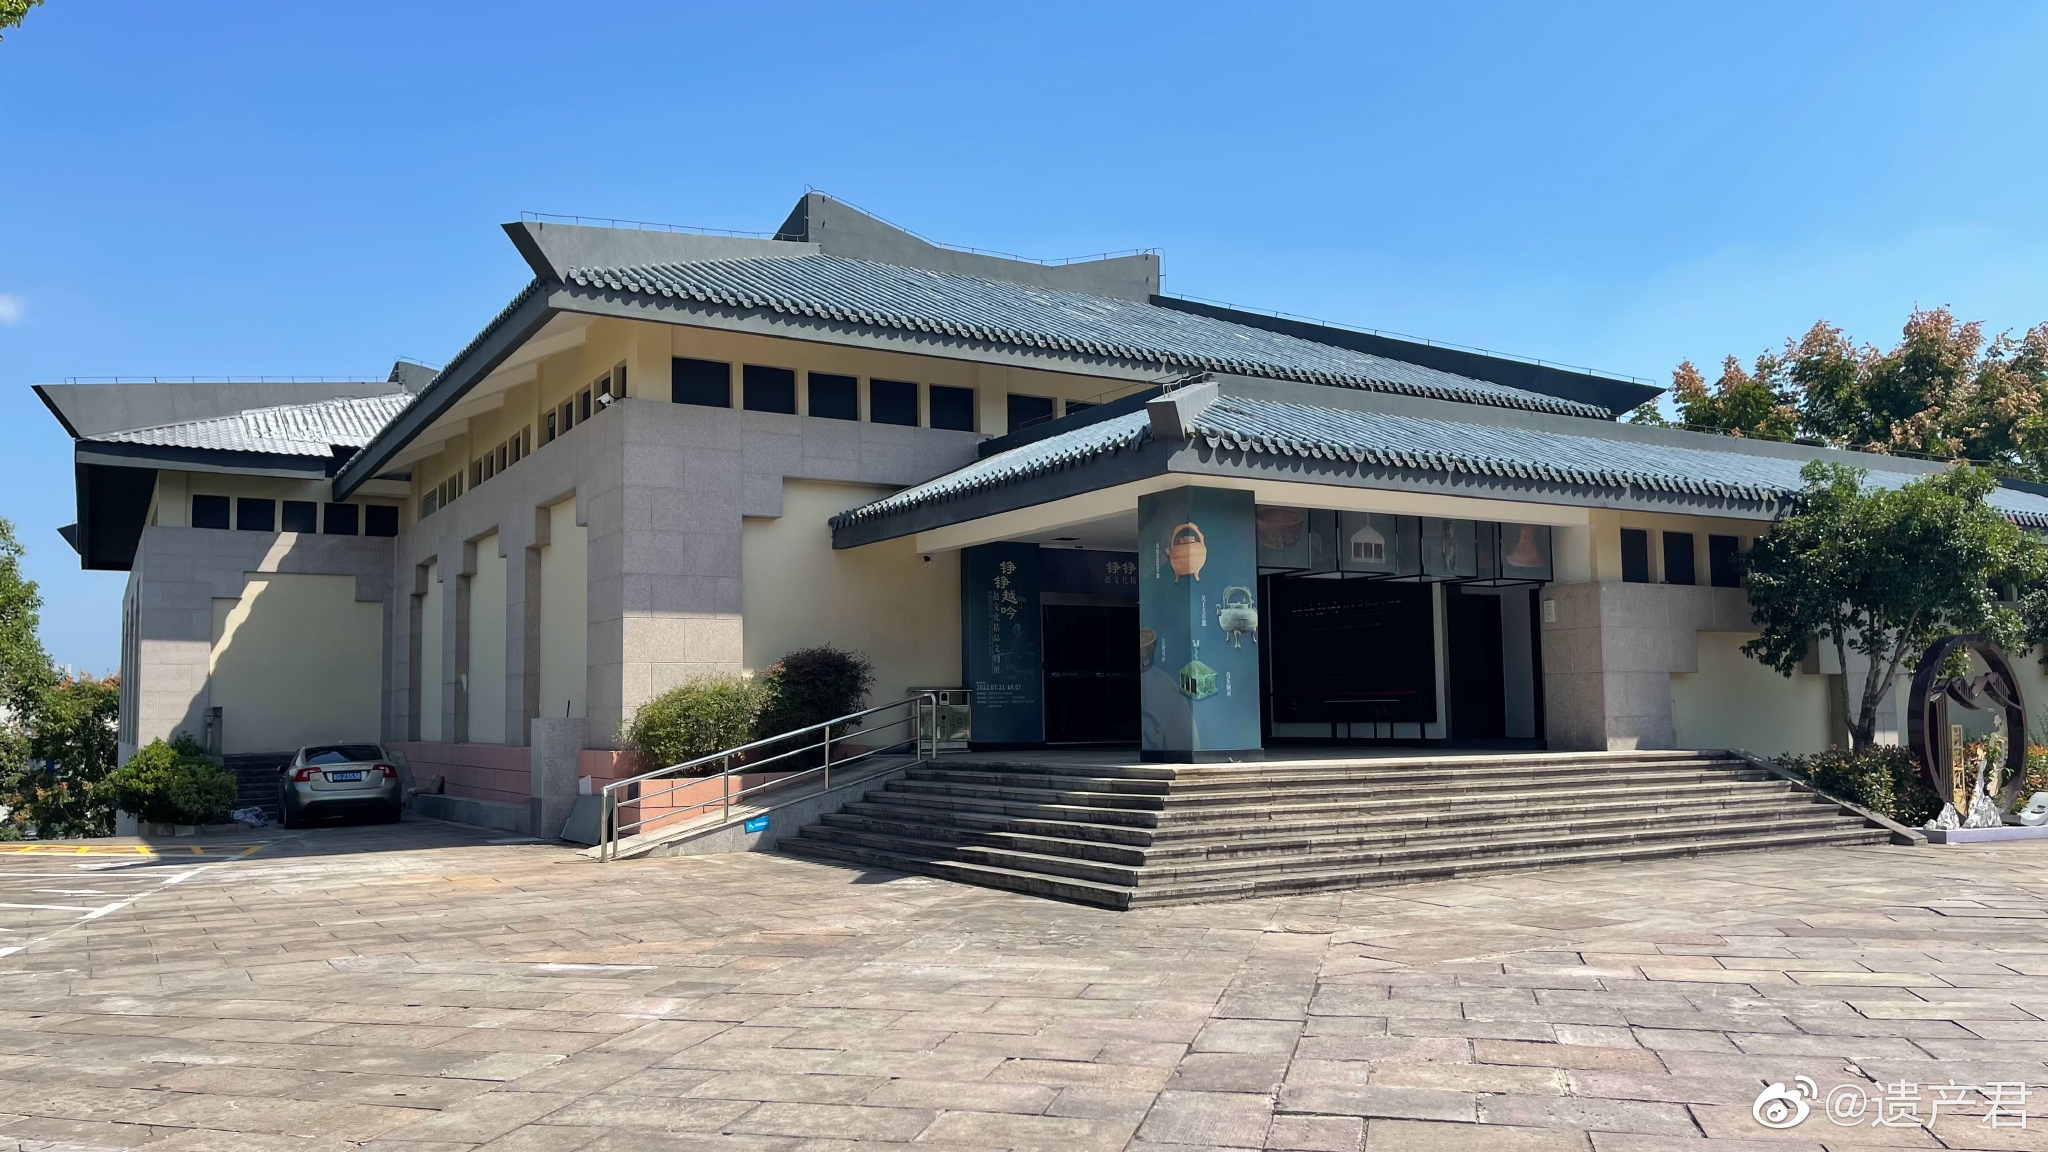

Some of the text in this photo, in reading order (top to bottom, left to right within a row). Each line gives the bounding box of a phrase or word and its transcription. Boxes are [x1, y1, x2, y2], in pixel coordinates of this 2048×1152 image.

[1105, 560, 1137, 575] 铮铮
[993, 560, 1018, 620] 铮铮越吟
